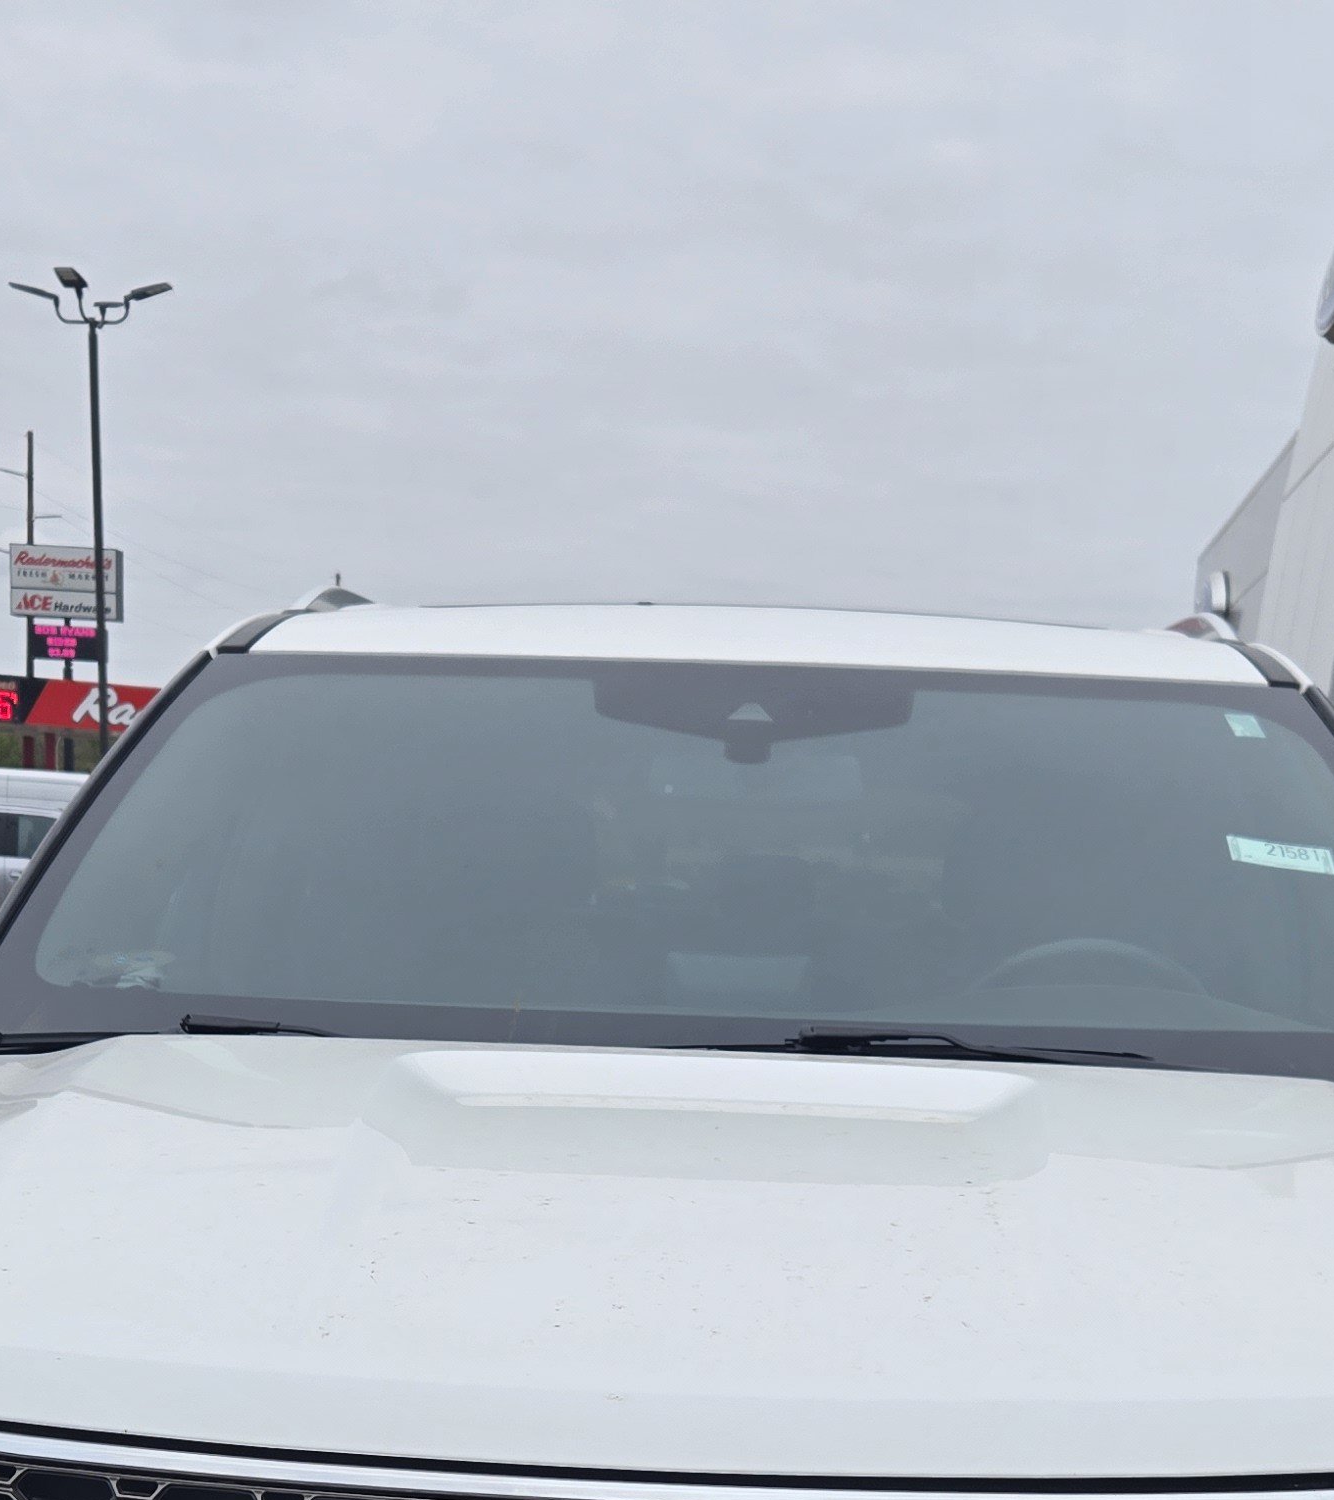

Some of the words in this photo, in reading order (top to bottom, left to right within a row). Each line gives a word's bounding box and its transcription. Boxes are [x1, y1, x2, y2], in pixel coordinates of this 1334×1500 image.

[13, 551, 113, 569] Radermache's
[17, 569, 47, 578] FRESH
[68, 572, 109, 581] MART
[15, 592, 53, 611] ACE
[53, 601, 112, 613] Hardwae
[1264, 843, 1320, 861] 21581
